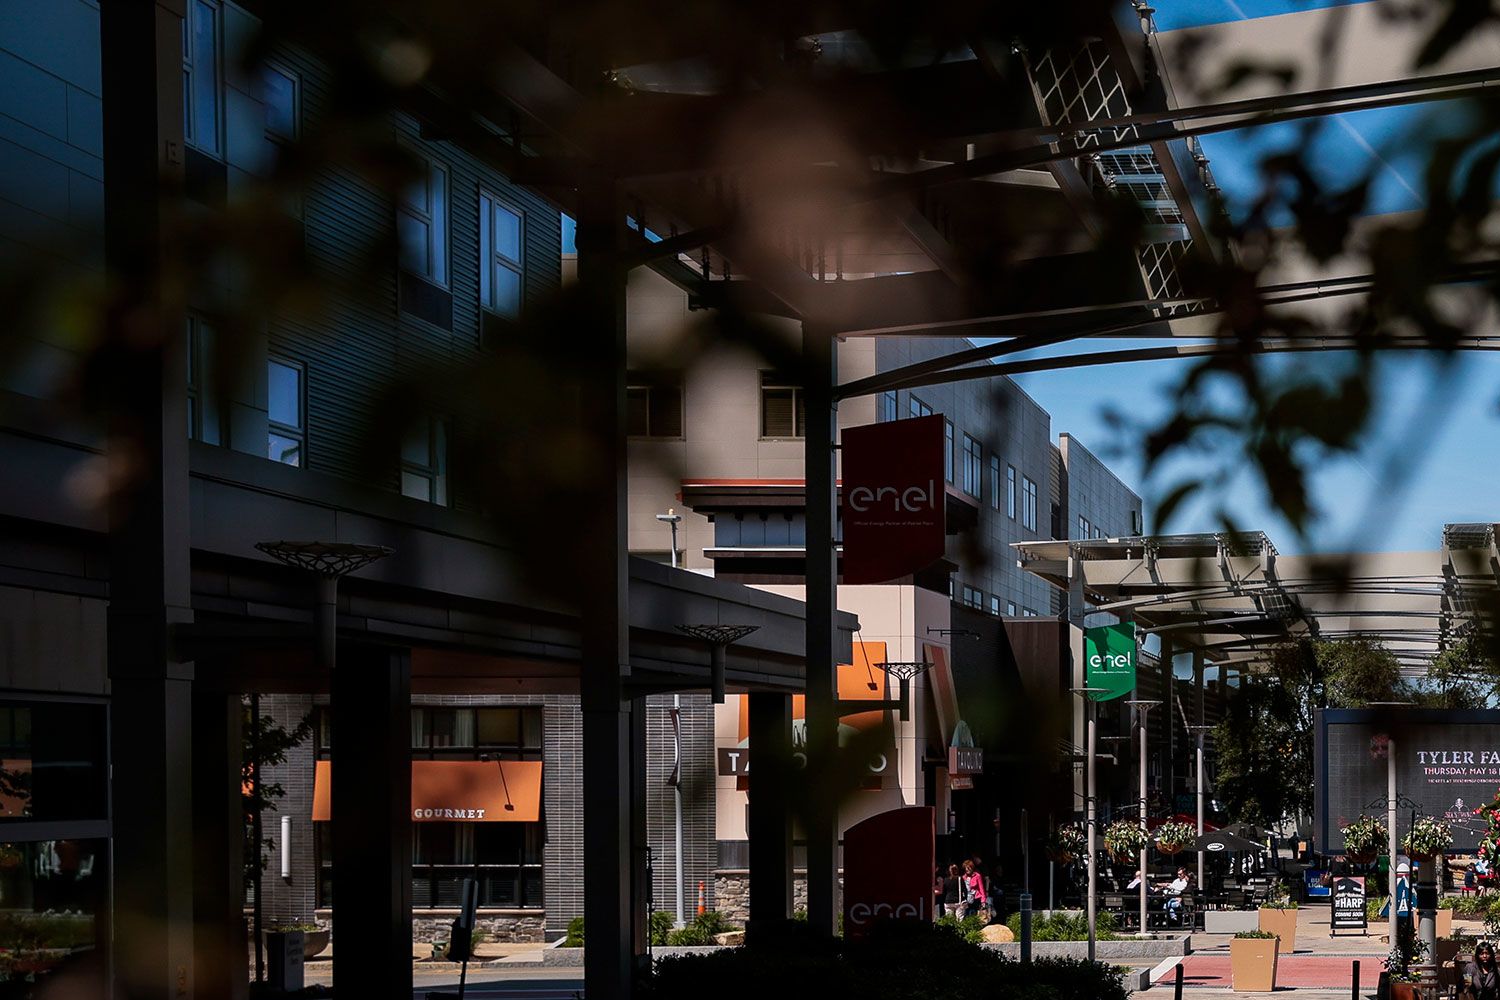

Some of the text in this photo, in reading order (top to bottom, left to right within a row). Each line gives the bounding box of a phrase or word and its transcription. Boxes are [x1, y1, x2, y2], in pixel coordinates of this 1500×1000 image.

[849, 479, 934, 512] enel
[1090, 651, 1131, 668] enel
[1416, 751, 1475, 764] TYLER
[1423, 767, 1467, 776] THURSDAY,
[1469, 767, 1486, 775] MAY
[1488, 767, 1497, 775] 18
[414, 808, 485, 819] GOURMET
[1340, 897, 1363, 909] HARP
[849, 896, 924, 925] enel
